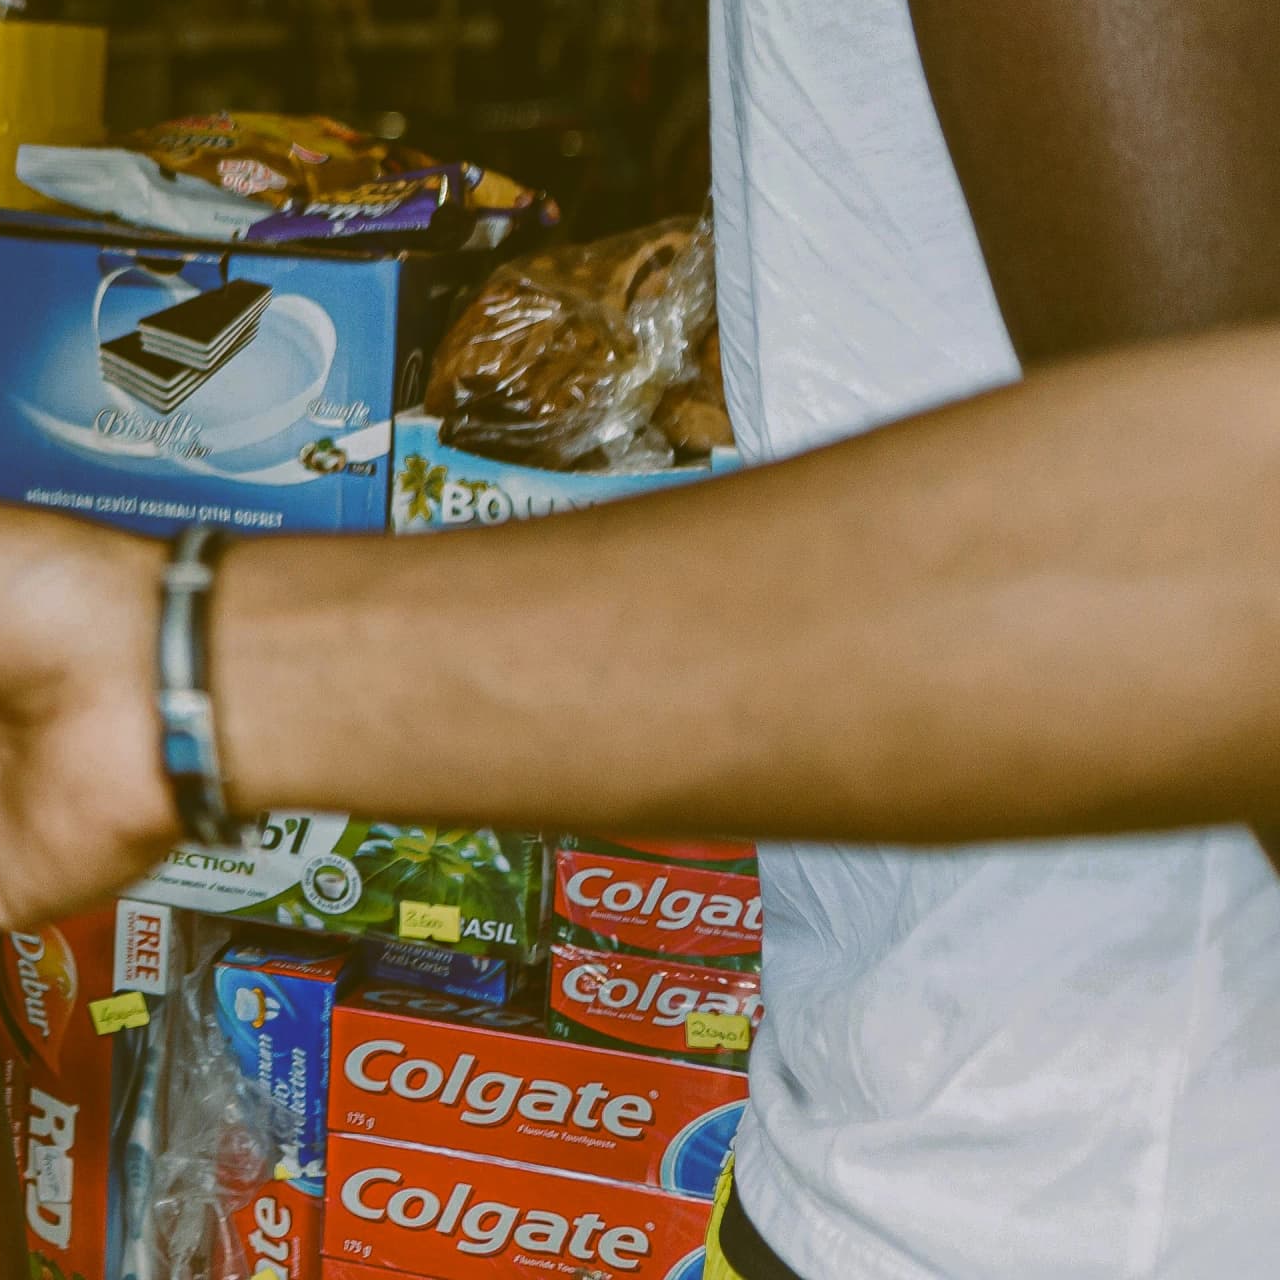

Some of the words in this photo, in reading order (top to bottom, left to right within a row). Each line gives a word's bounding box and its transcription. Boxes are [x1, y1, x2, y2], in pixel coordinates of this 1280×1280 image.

[166, 850, 256, 877] TECTION
[565, 867, 762, 931] Colgat
[137, 914, 161, 982] FREE
[10, 930, 50, 1038] Dabur
[343, 1039, 655, 1138] Colgate
[516, 1124, 560, 1141] Fluoride
[560, 1128, 617, 1150] Toothpaste
[341, 1167, 651, 1270] Colgate
